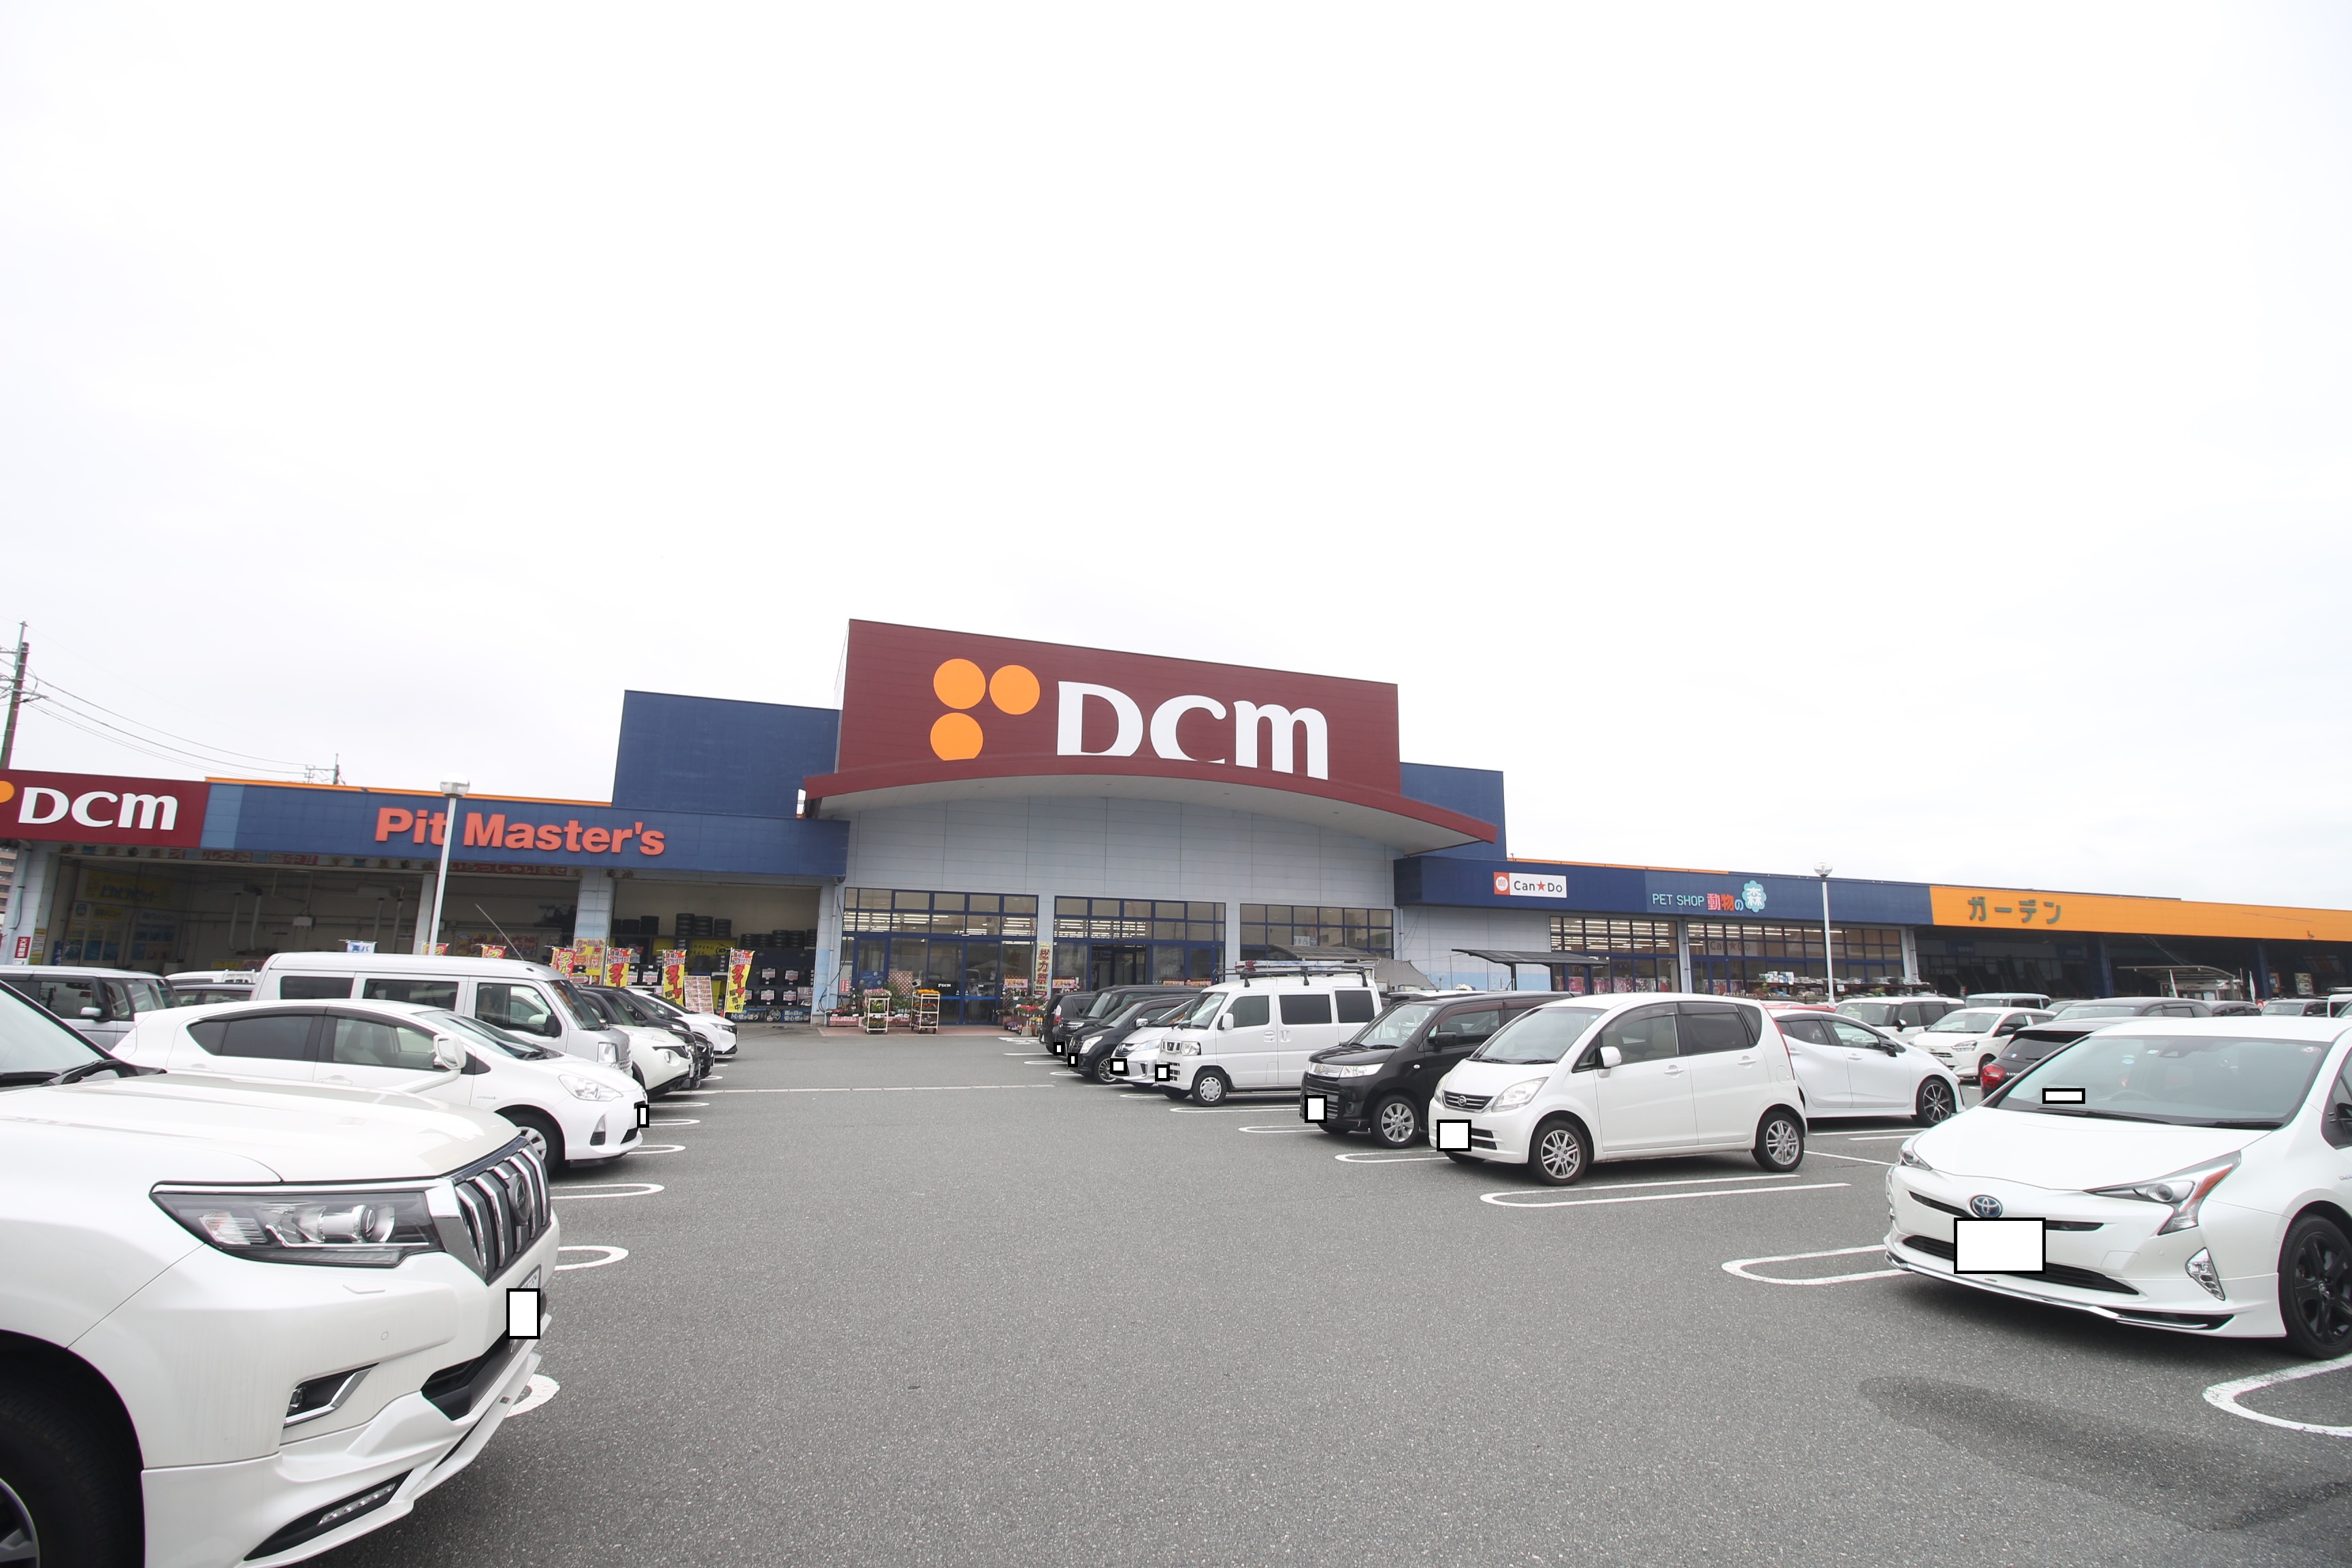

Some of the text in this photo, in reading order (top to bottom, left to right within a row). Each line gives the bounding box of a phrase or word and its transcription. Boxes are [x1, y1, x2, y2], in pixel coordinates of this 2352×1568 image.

[375, 808, 666, 856] Pit Master's
[1652, 887, 1763, 911] PET SHOP 動物の森
[1969, 896, 2062, 924] ガーデン
[732, 965, 745, 998] タイヤ
